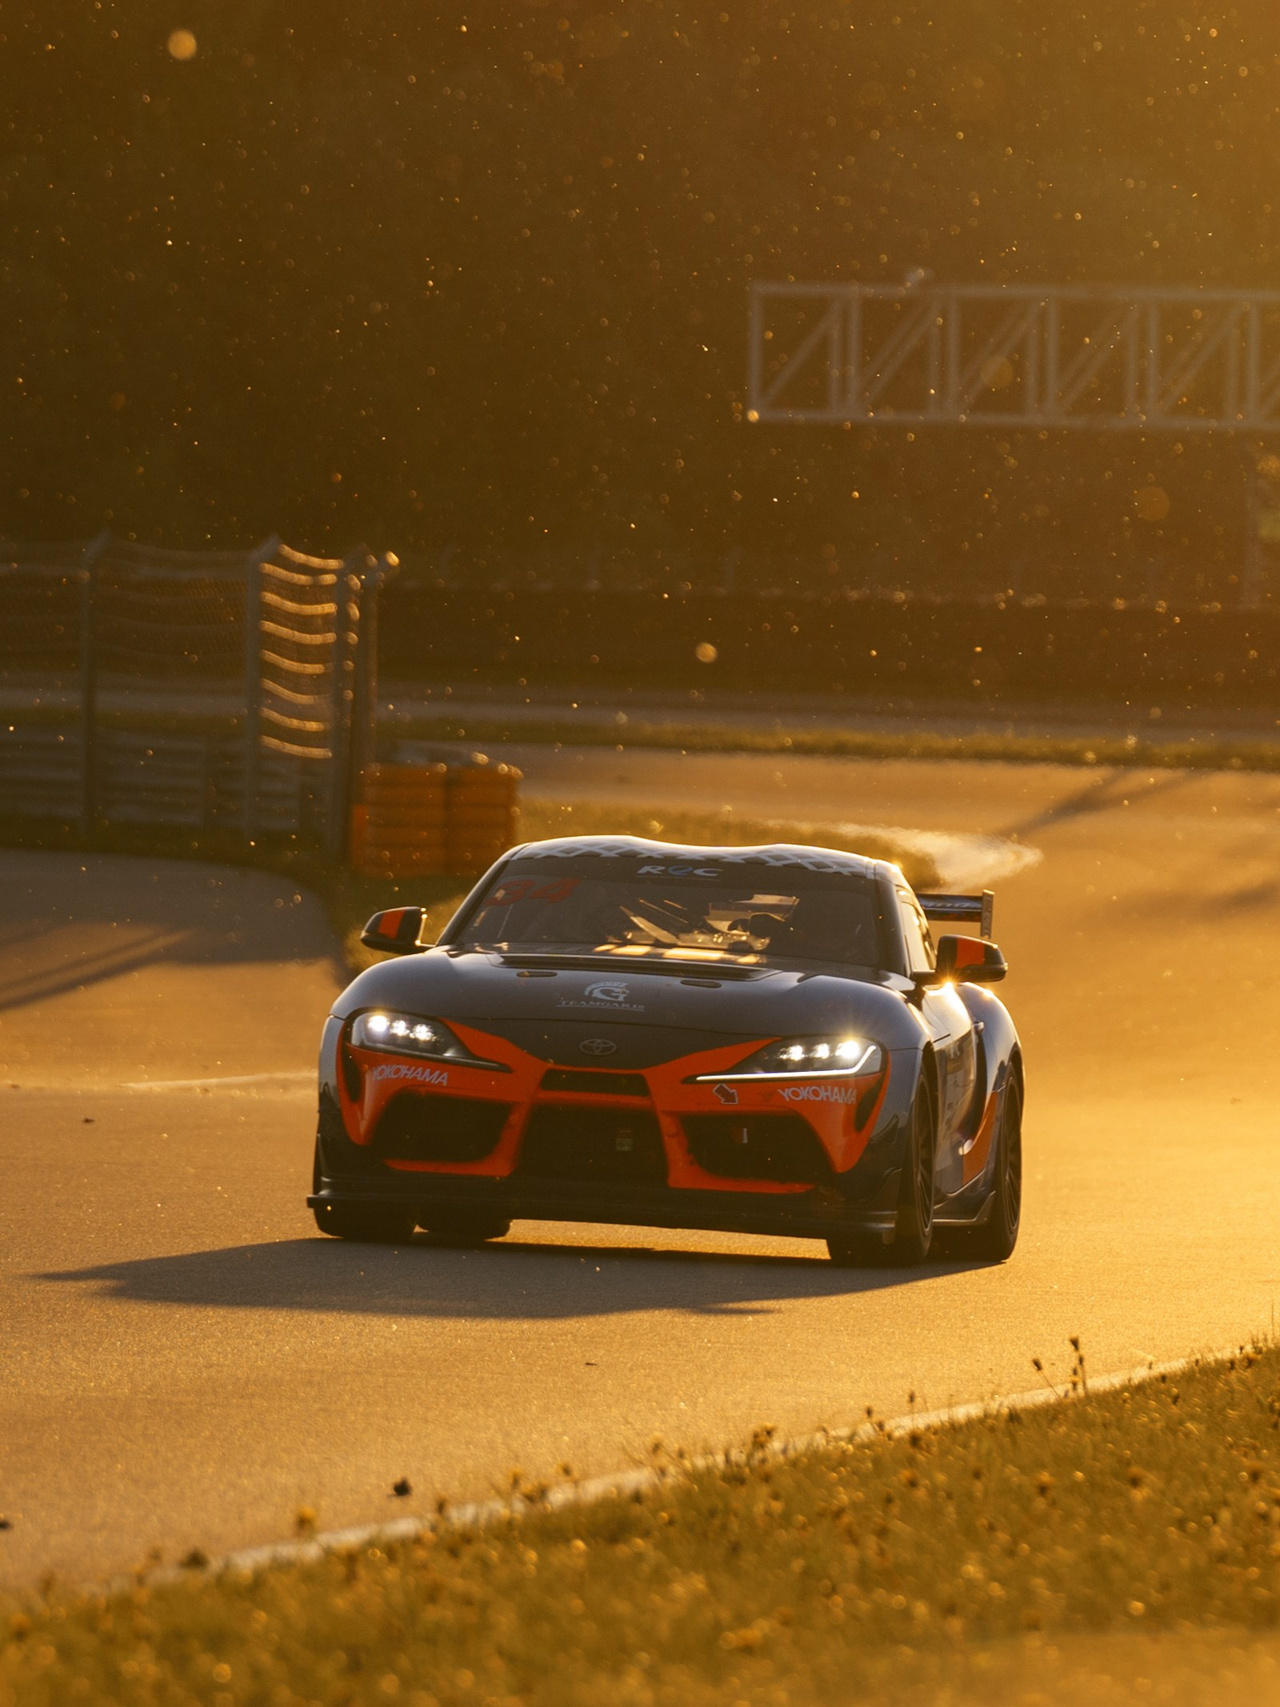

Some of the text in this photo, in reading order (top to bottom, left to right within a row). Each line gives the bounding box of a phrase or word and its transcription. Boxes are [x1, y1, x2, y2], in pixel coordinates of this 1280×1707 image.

[485, 878, 582, 907] 34
[372, 1064, 449, 1086] YOKOHAMA
[777, 1085, 857, 1104] YOKOHAMA
